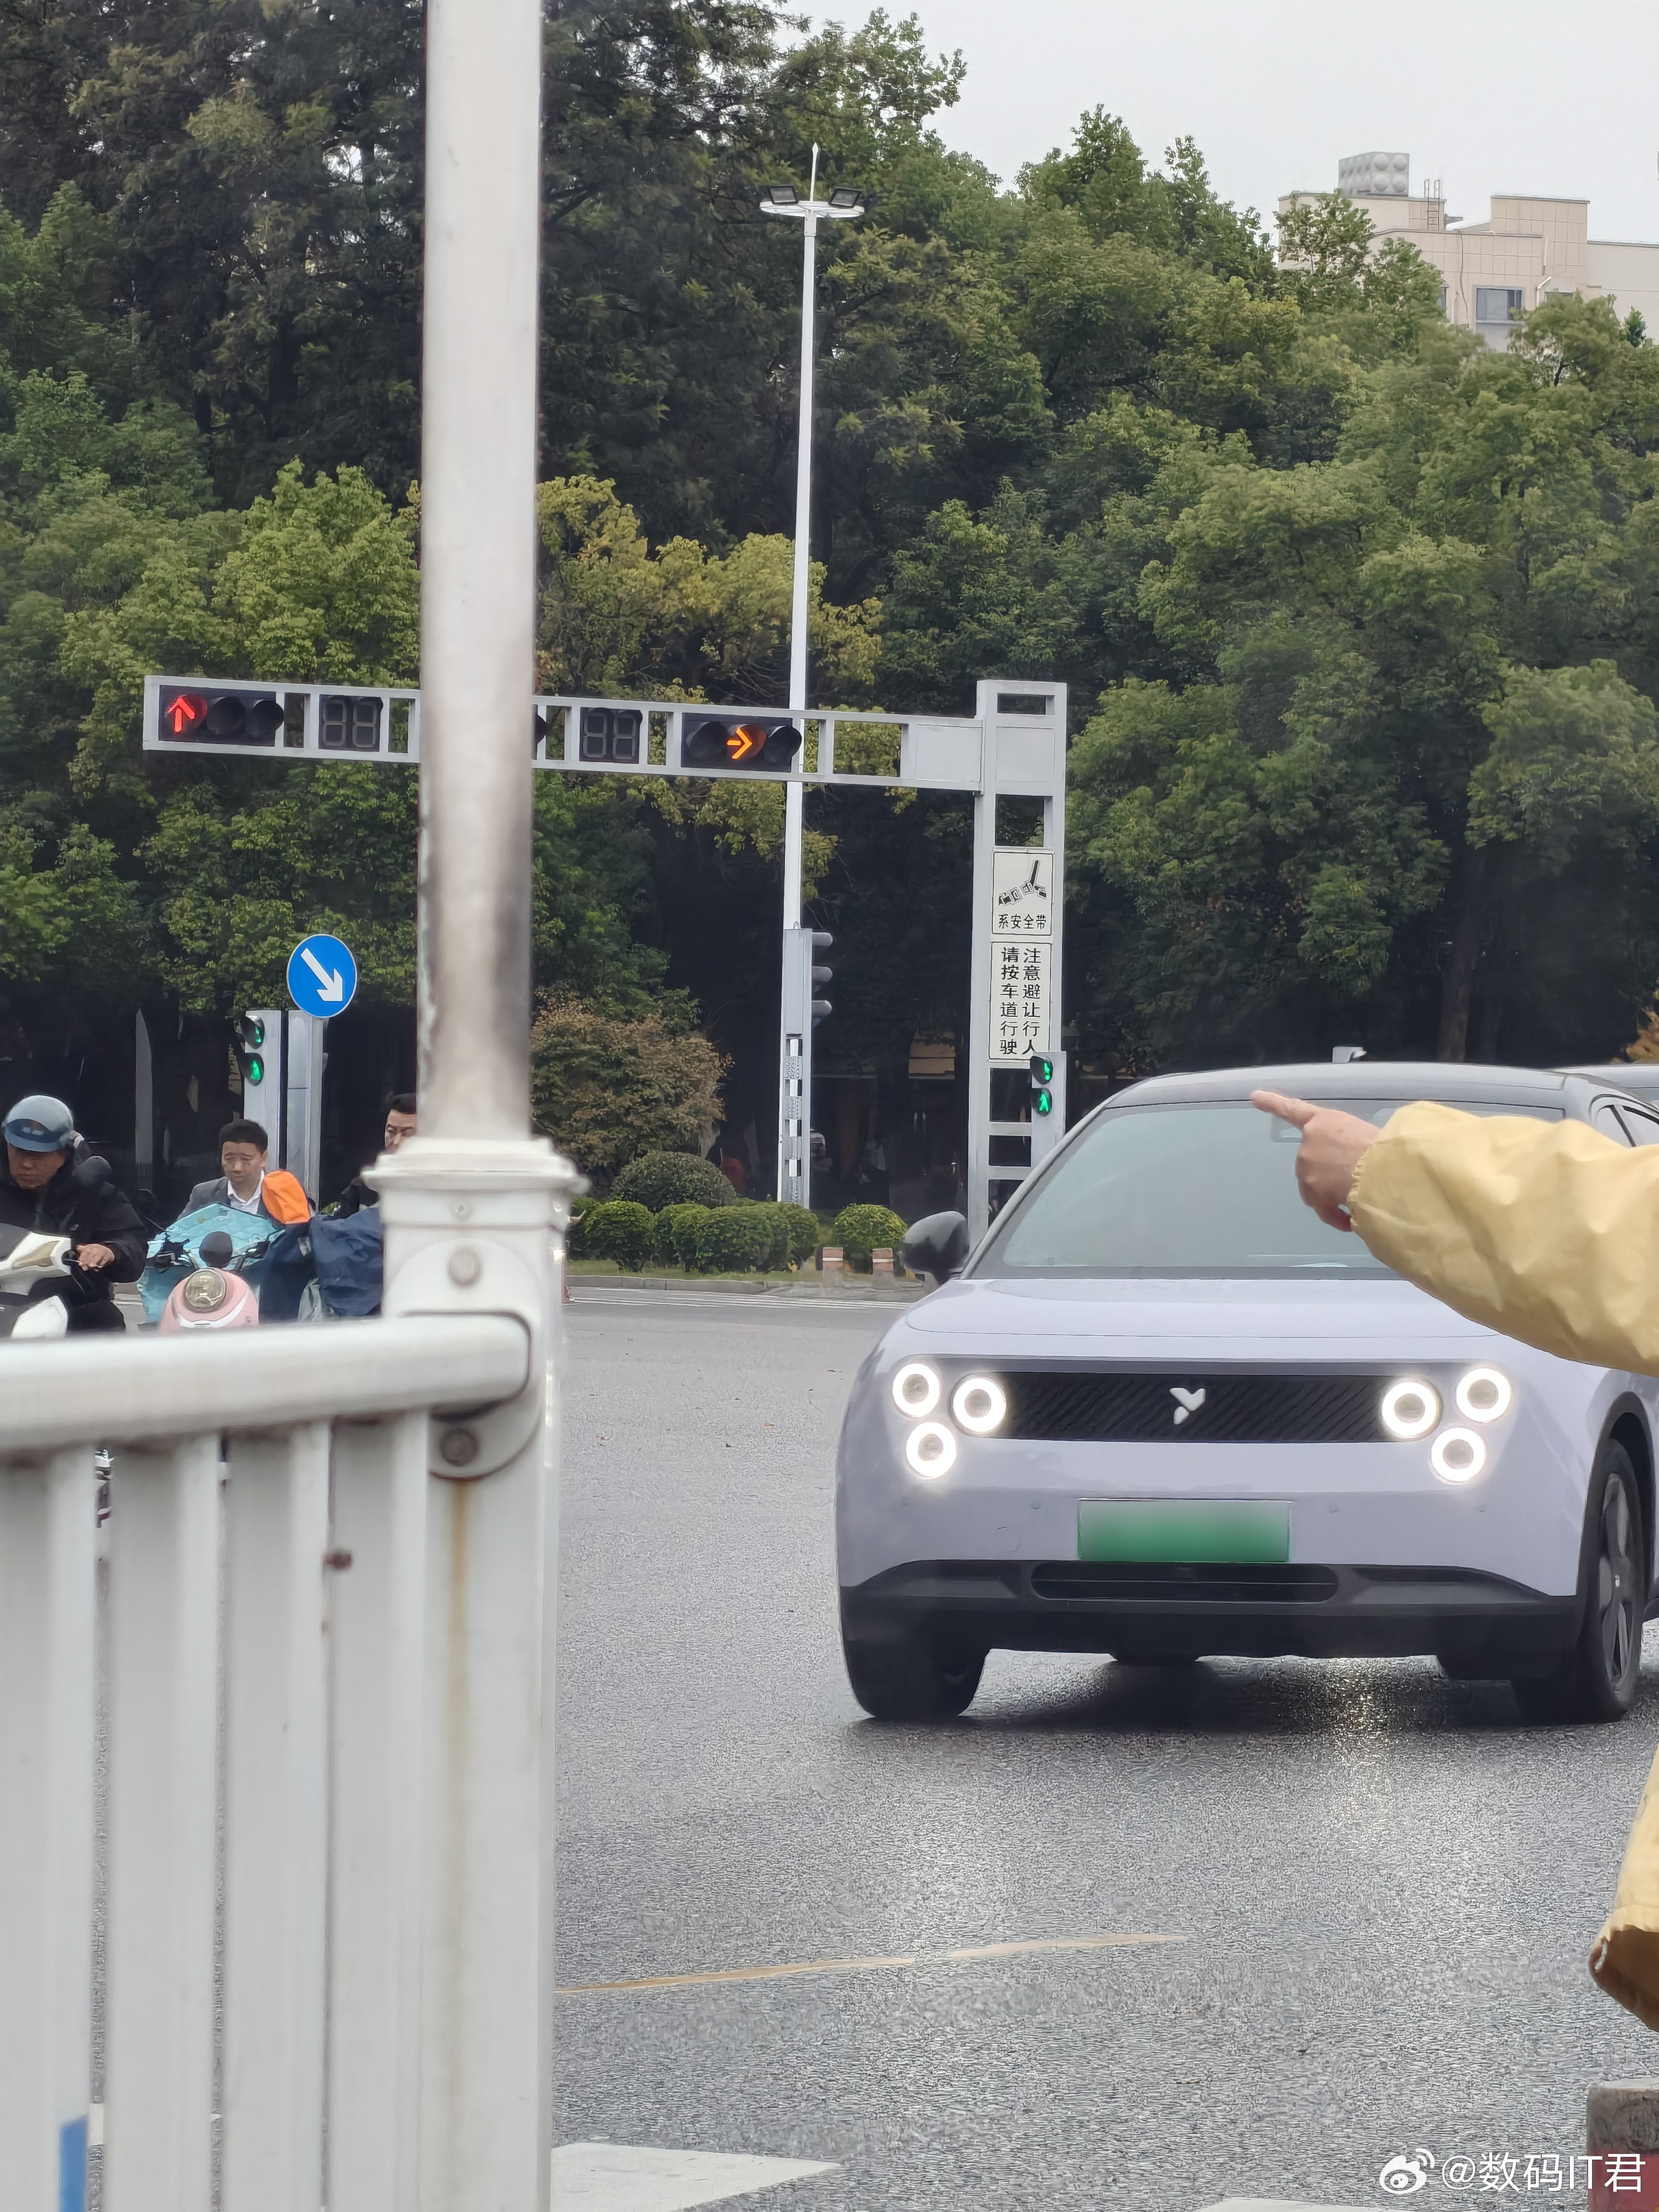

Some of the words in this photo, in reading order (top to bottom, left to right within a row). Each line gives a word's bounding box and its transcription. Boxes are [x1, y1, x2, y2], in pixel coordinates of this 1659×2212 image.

[999, 914, 1046, 929] 系安全带
[999, 947, 1020, 1055] 请按车道行驶
[1022, 948, 1041, 1055] 注意避让行人
